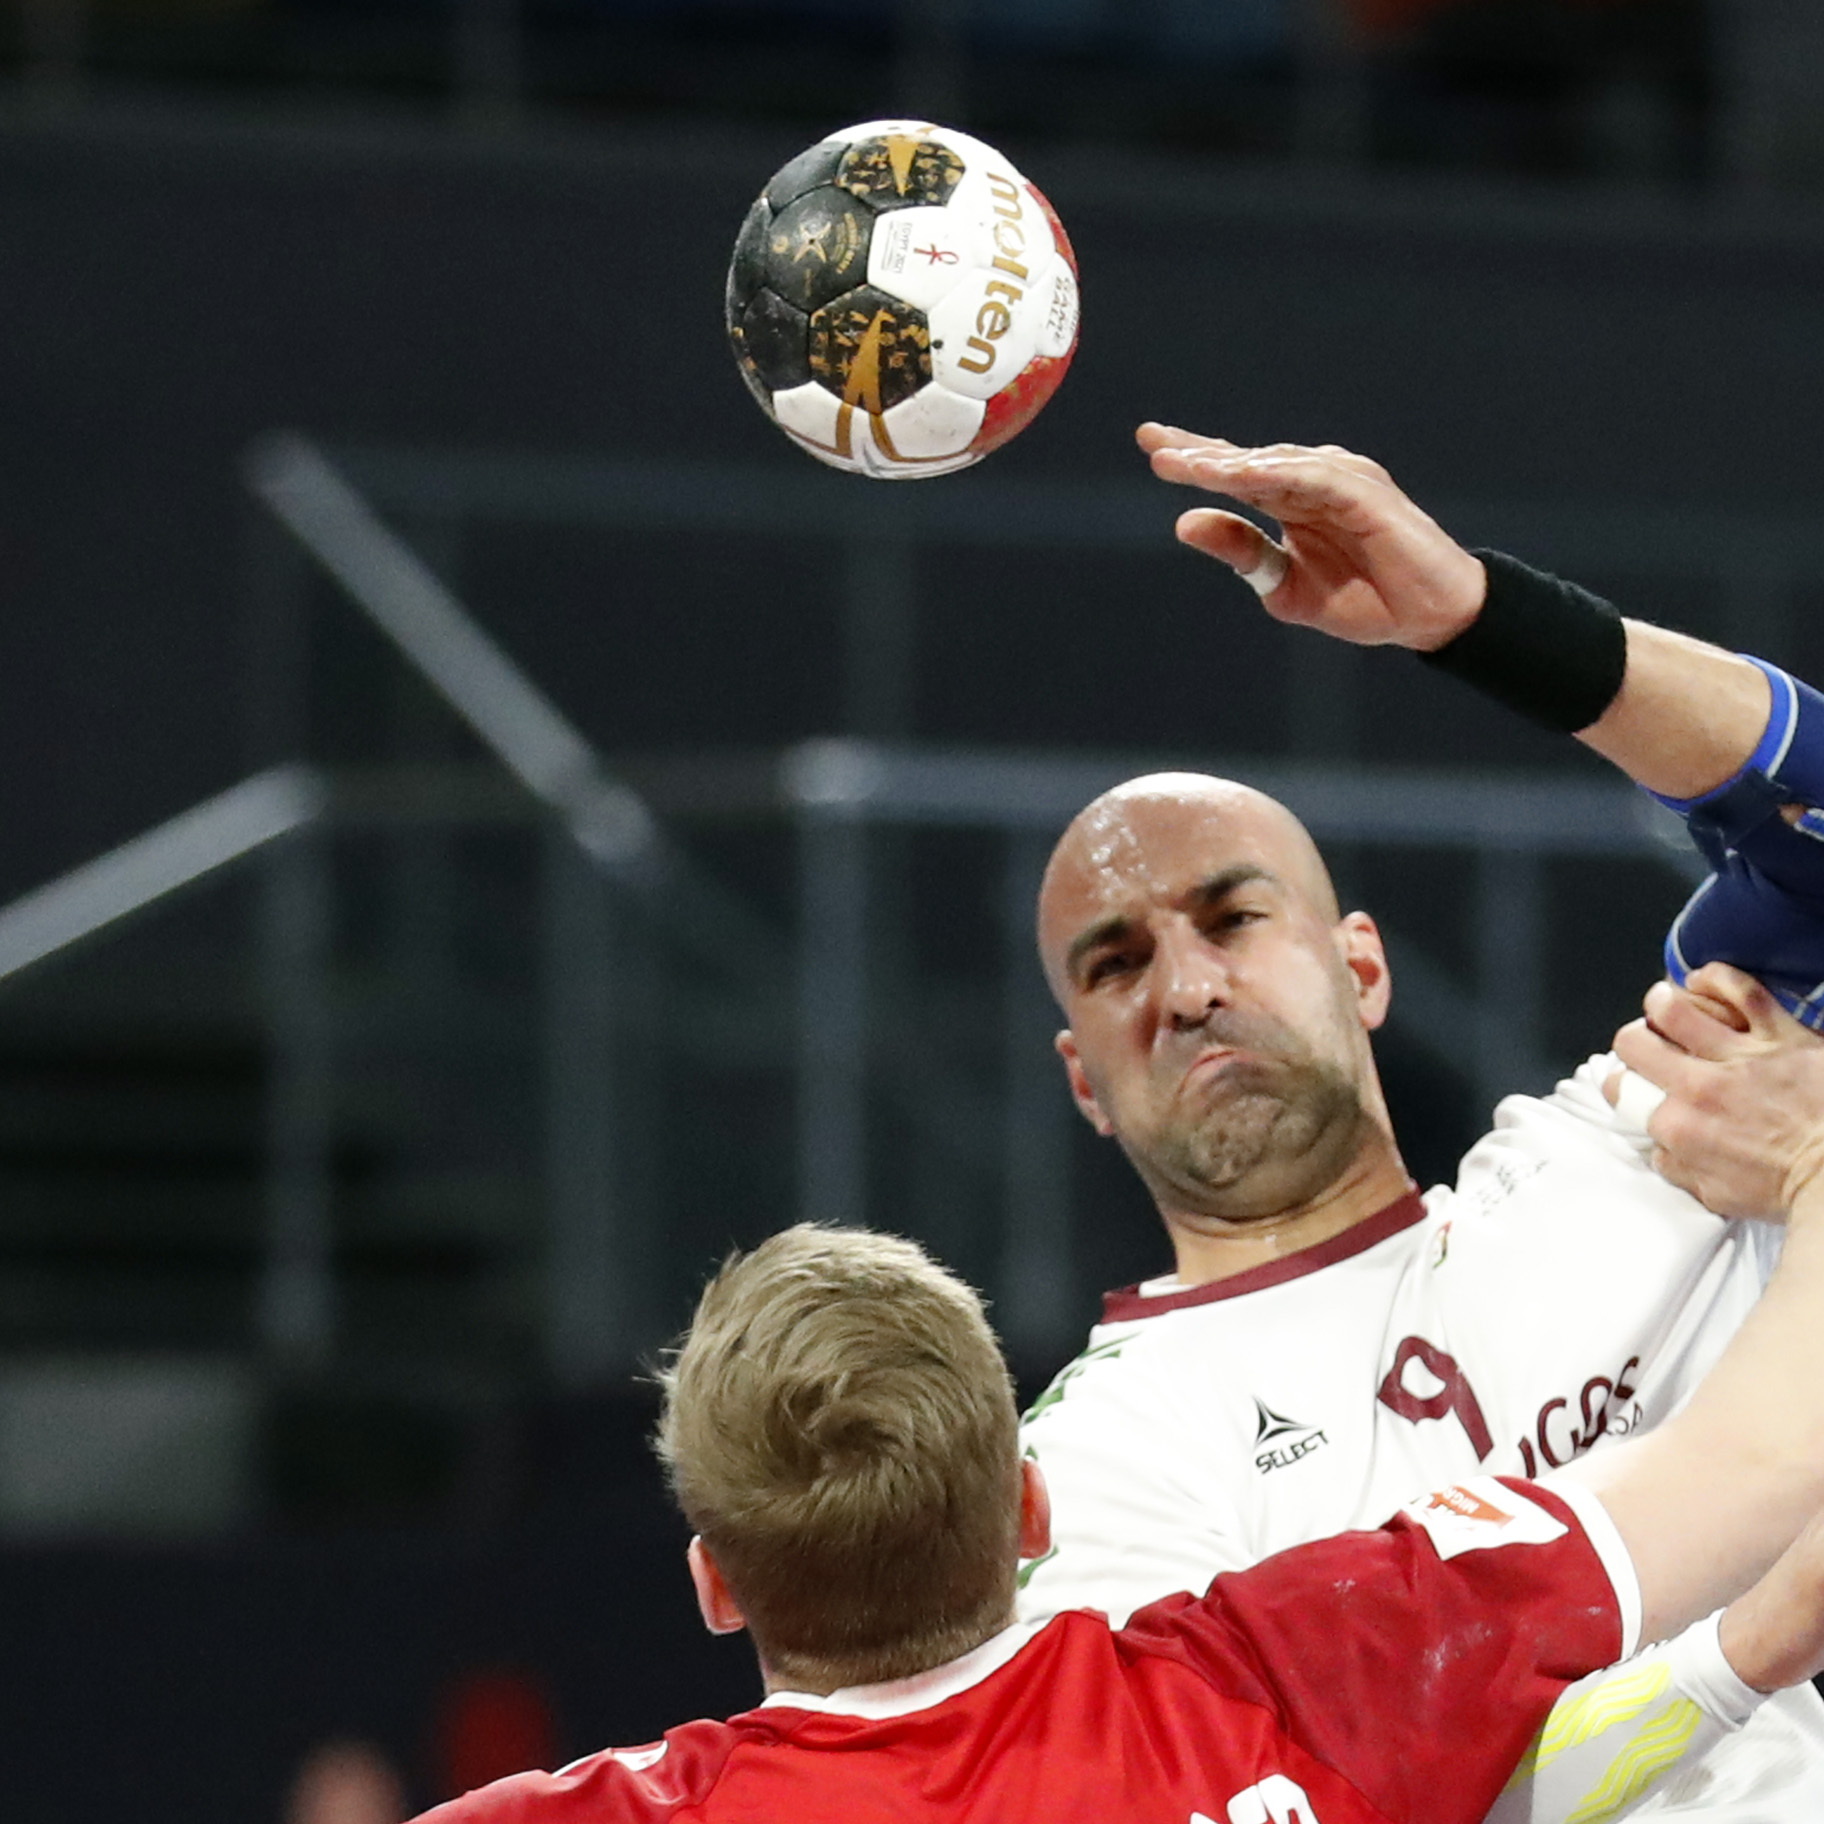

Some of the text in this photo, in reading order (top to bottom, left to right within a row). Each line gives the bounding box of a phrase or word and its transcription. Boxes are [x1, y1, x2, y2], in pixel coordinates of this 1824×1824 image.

[957, 171, 1029, 375] molten
[1255, 1429, 1329, 1475] SELECT
[1379, 1335, 1493, 1462] 9
